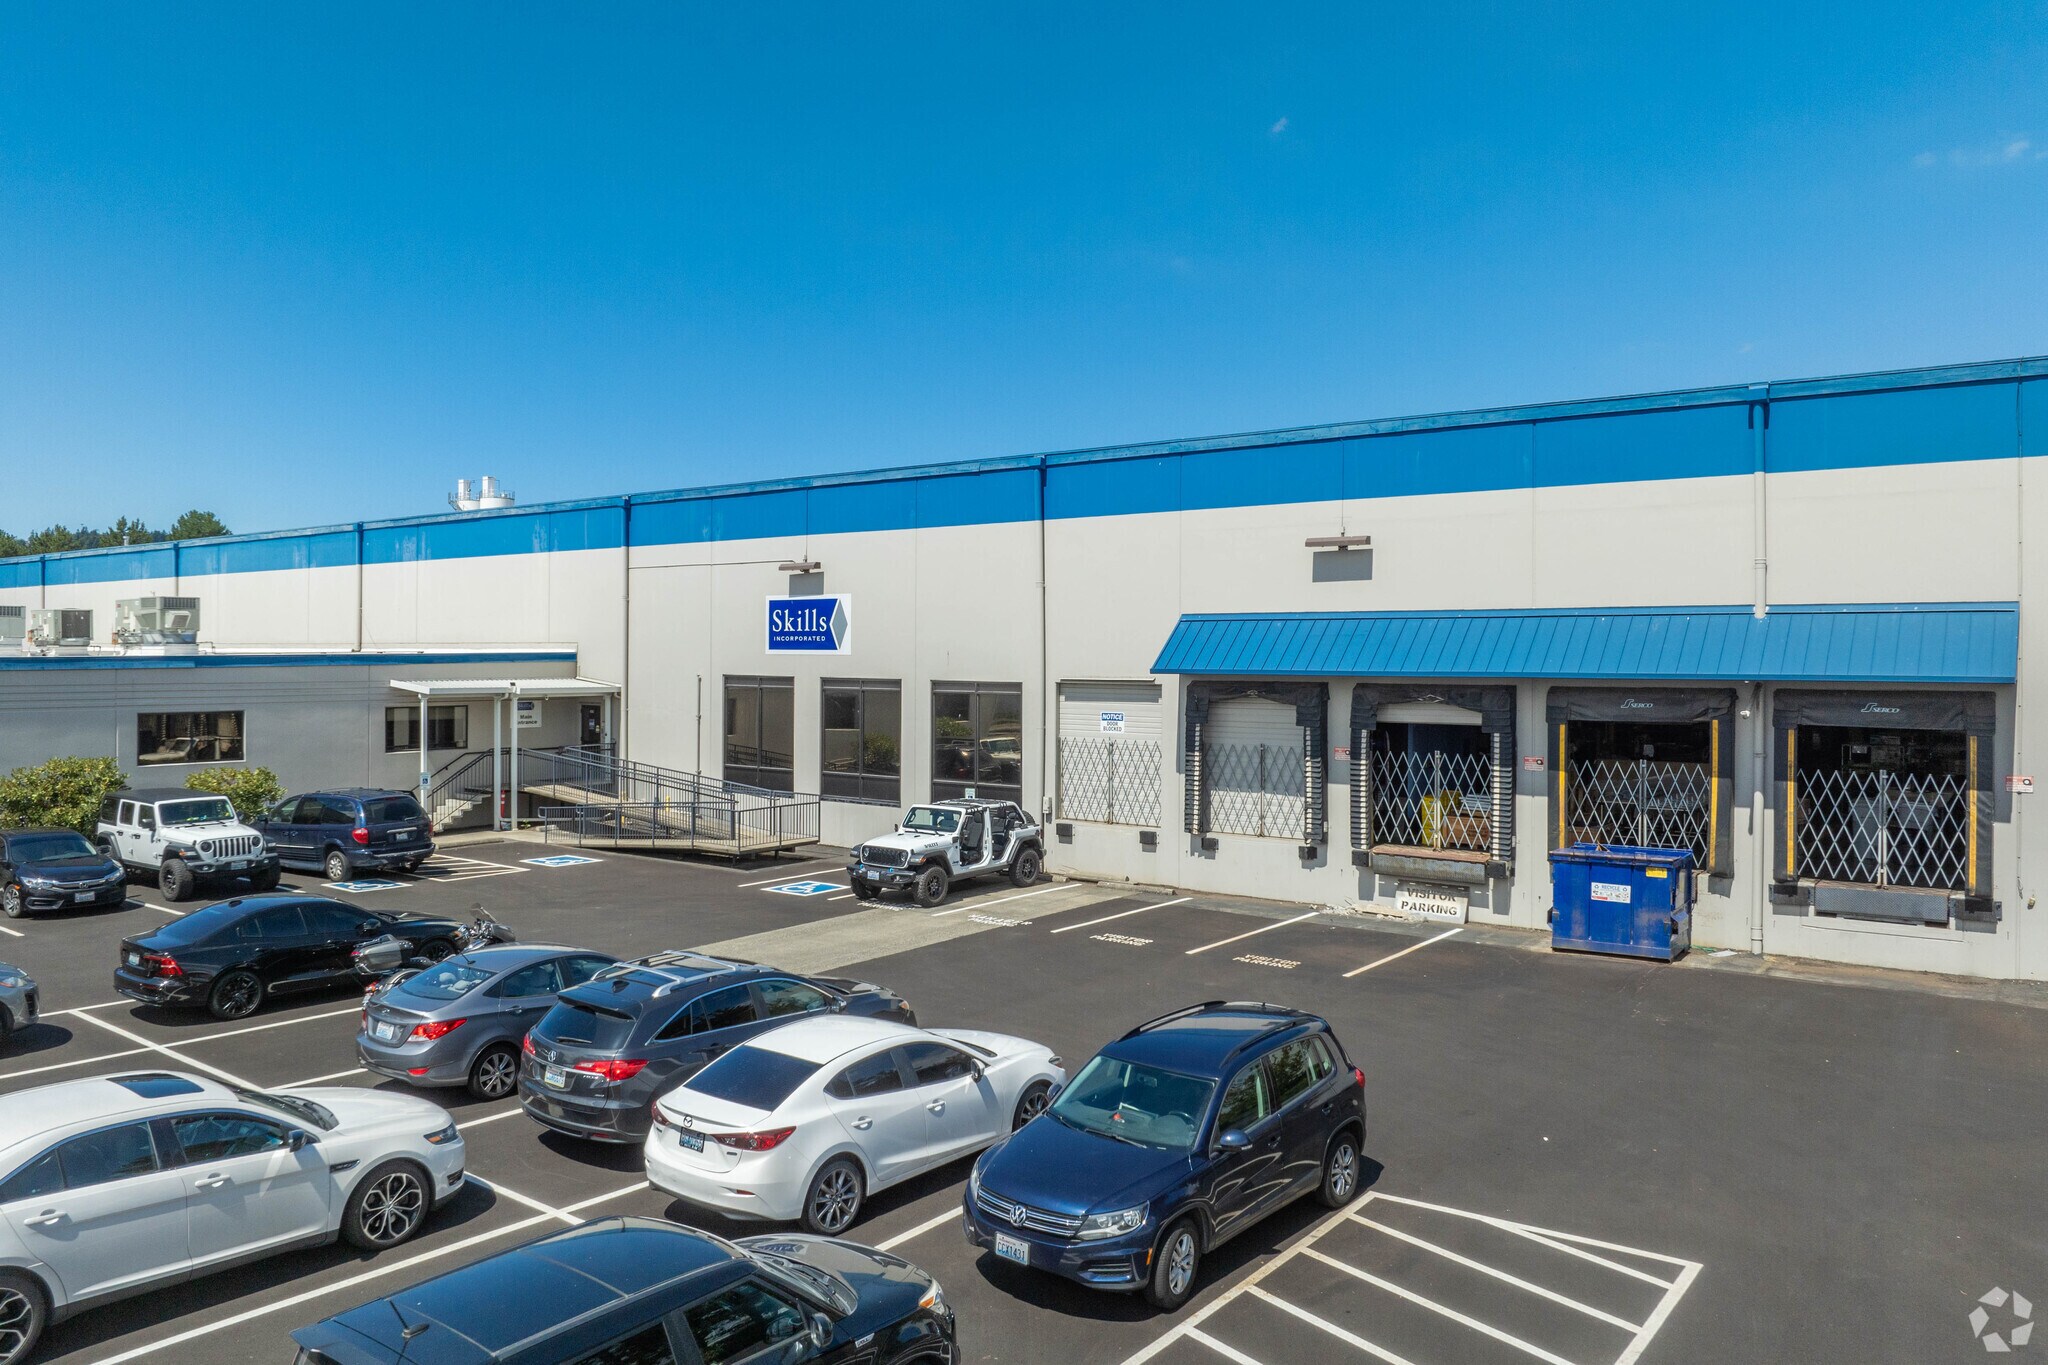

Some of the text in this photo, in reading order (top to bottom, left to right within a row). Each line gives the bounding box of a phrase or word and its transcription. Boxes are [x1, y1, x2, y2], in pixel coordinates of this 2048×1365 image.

[772, 608, 827, 632] Skills
[1407, 887, 1456, 902] VISITOR
[1401, 900, 1458, 916] PARKING
[1089, 935, 1146, 946] PARKING
[1103, 933, 1154, 944] VISITOR
[1232, 956, 1296, 969] PARKING
[1245, 954, 1302, 966] VISITOR
